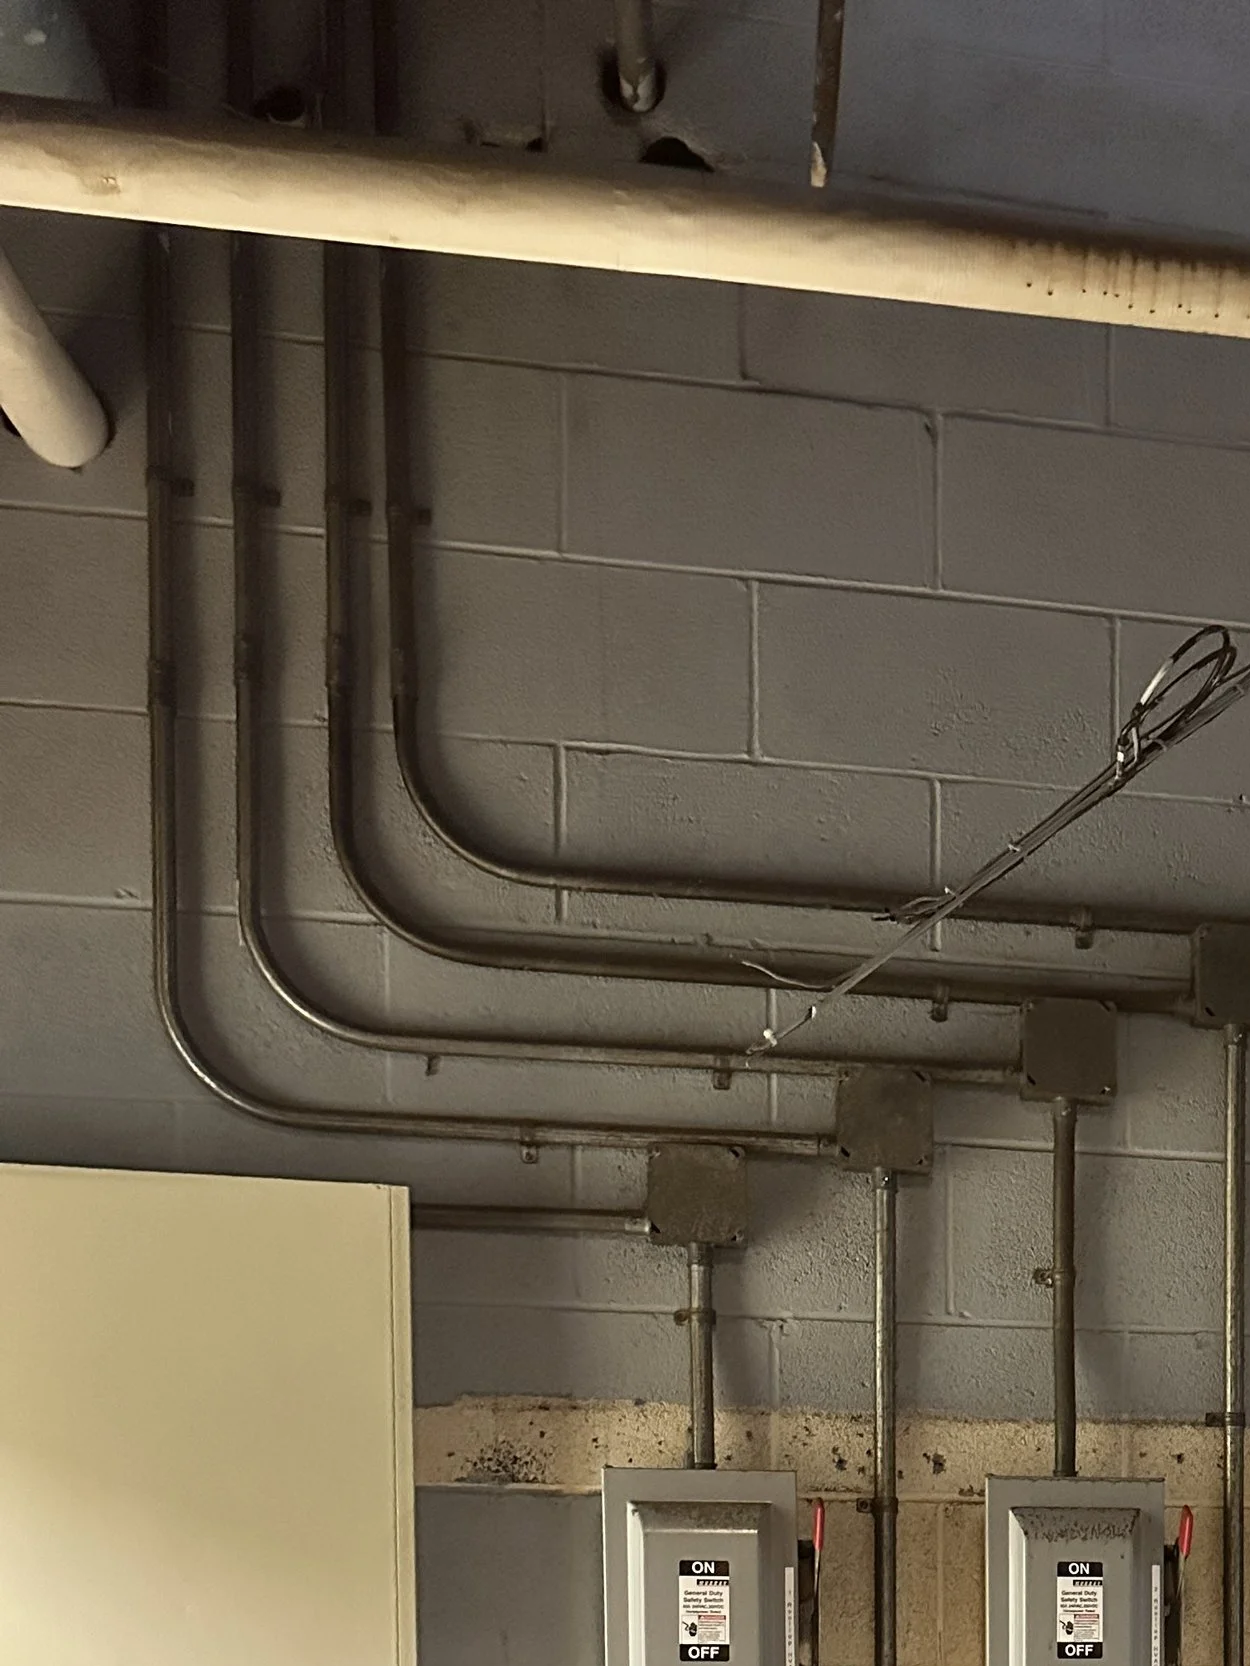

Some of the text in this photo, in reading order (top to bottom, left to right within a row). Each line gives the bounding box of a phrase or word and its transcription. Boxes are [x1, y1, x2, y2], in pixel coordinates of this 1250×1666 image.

[691, 1561, 715, 1574] ON
[1068, 1563, 1090, 1575] ON
[688, 1646, 719, 1659] OFF
[1064, 1644, 1094, 1657] OFF
